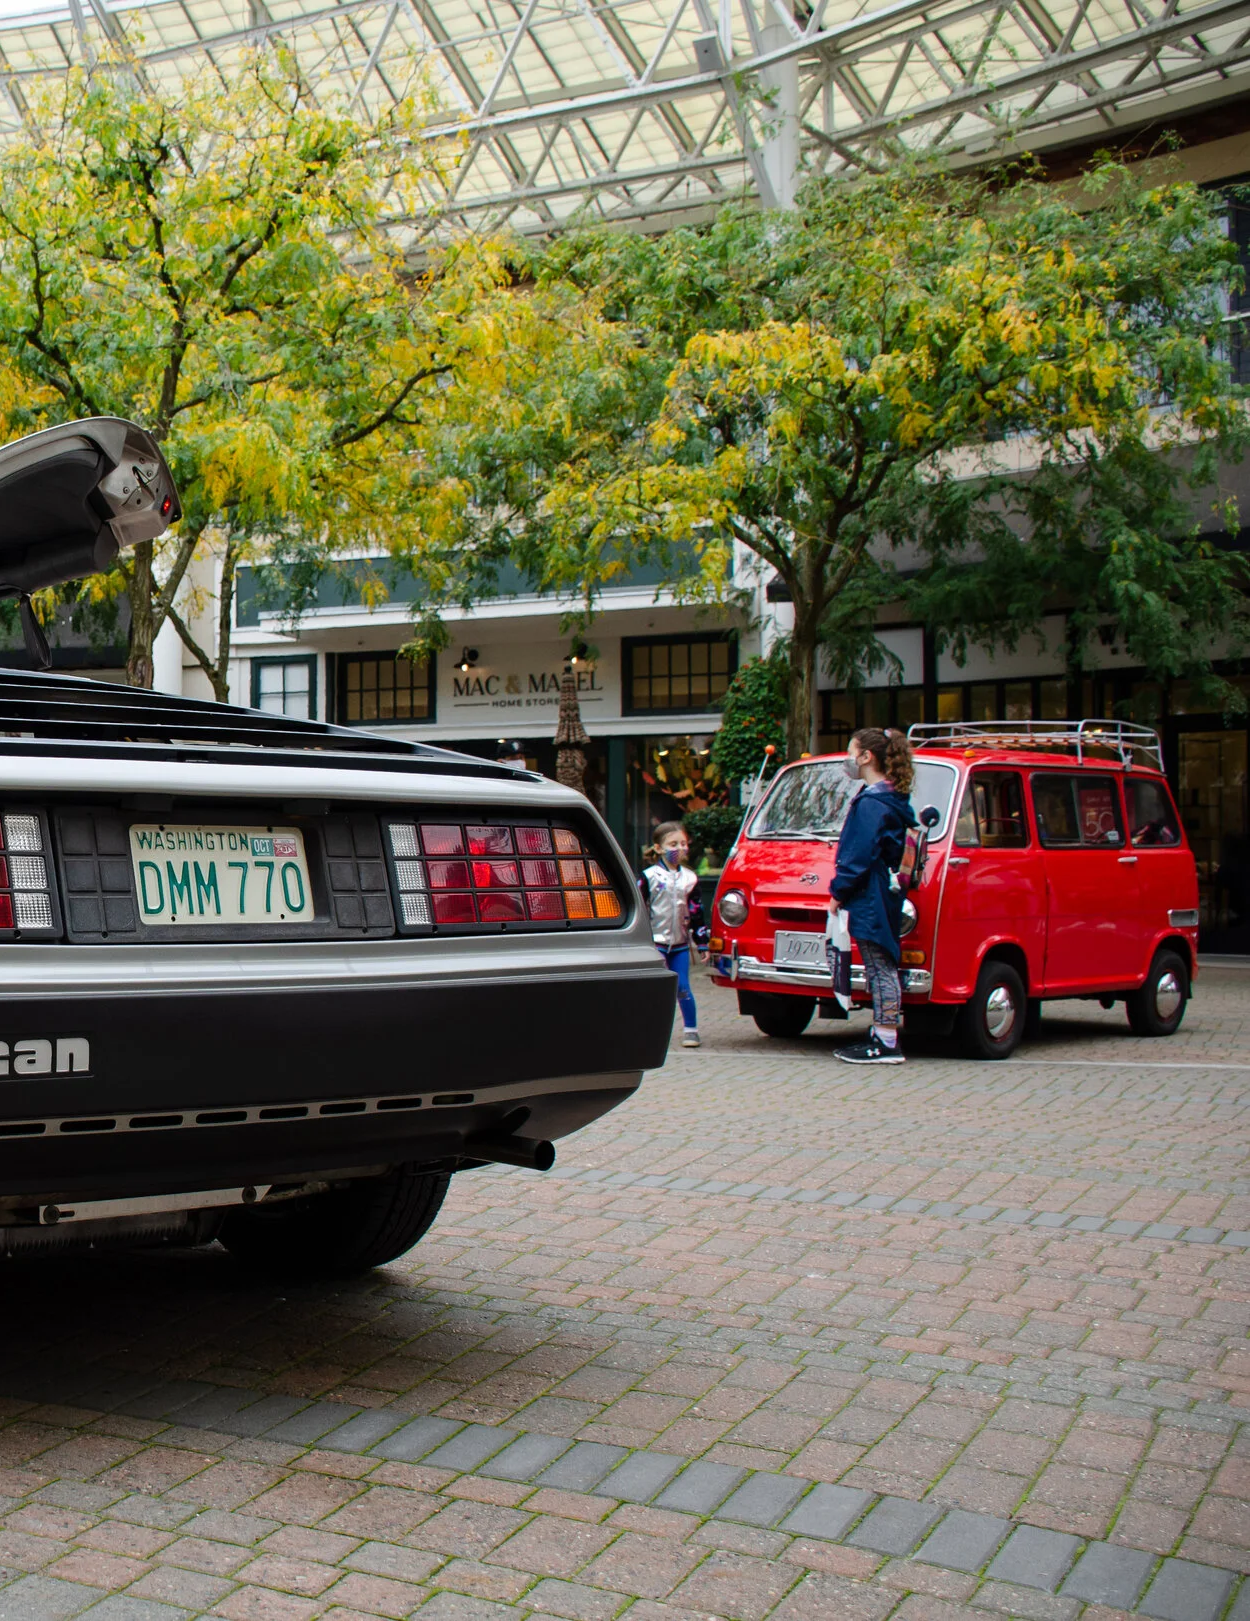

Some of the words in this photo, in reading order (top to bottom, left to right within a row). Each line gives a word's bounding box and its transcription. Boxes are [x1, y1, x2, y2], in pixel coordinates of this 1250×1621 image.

[453, 675, 500, 697] MAC
[505, 674, 522, 694] &
[529, 671, 603, 693] MAEL
[492, 699, 523, 707] HOME
[525, 698, 560, 707] STORE
[134, 831, 249, 851] WASHINGTON
[254, 839, 270, 853] OCT
[787, 940, 819, 958] 1970
